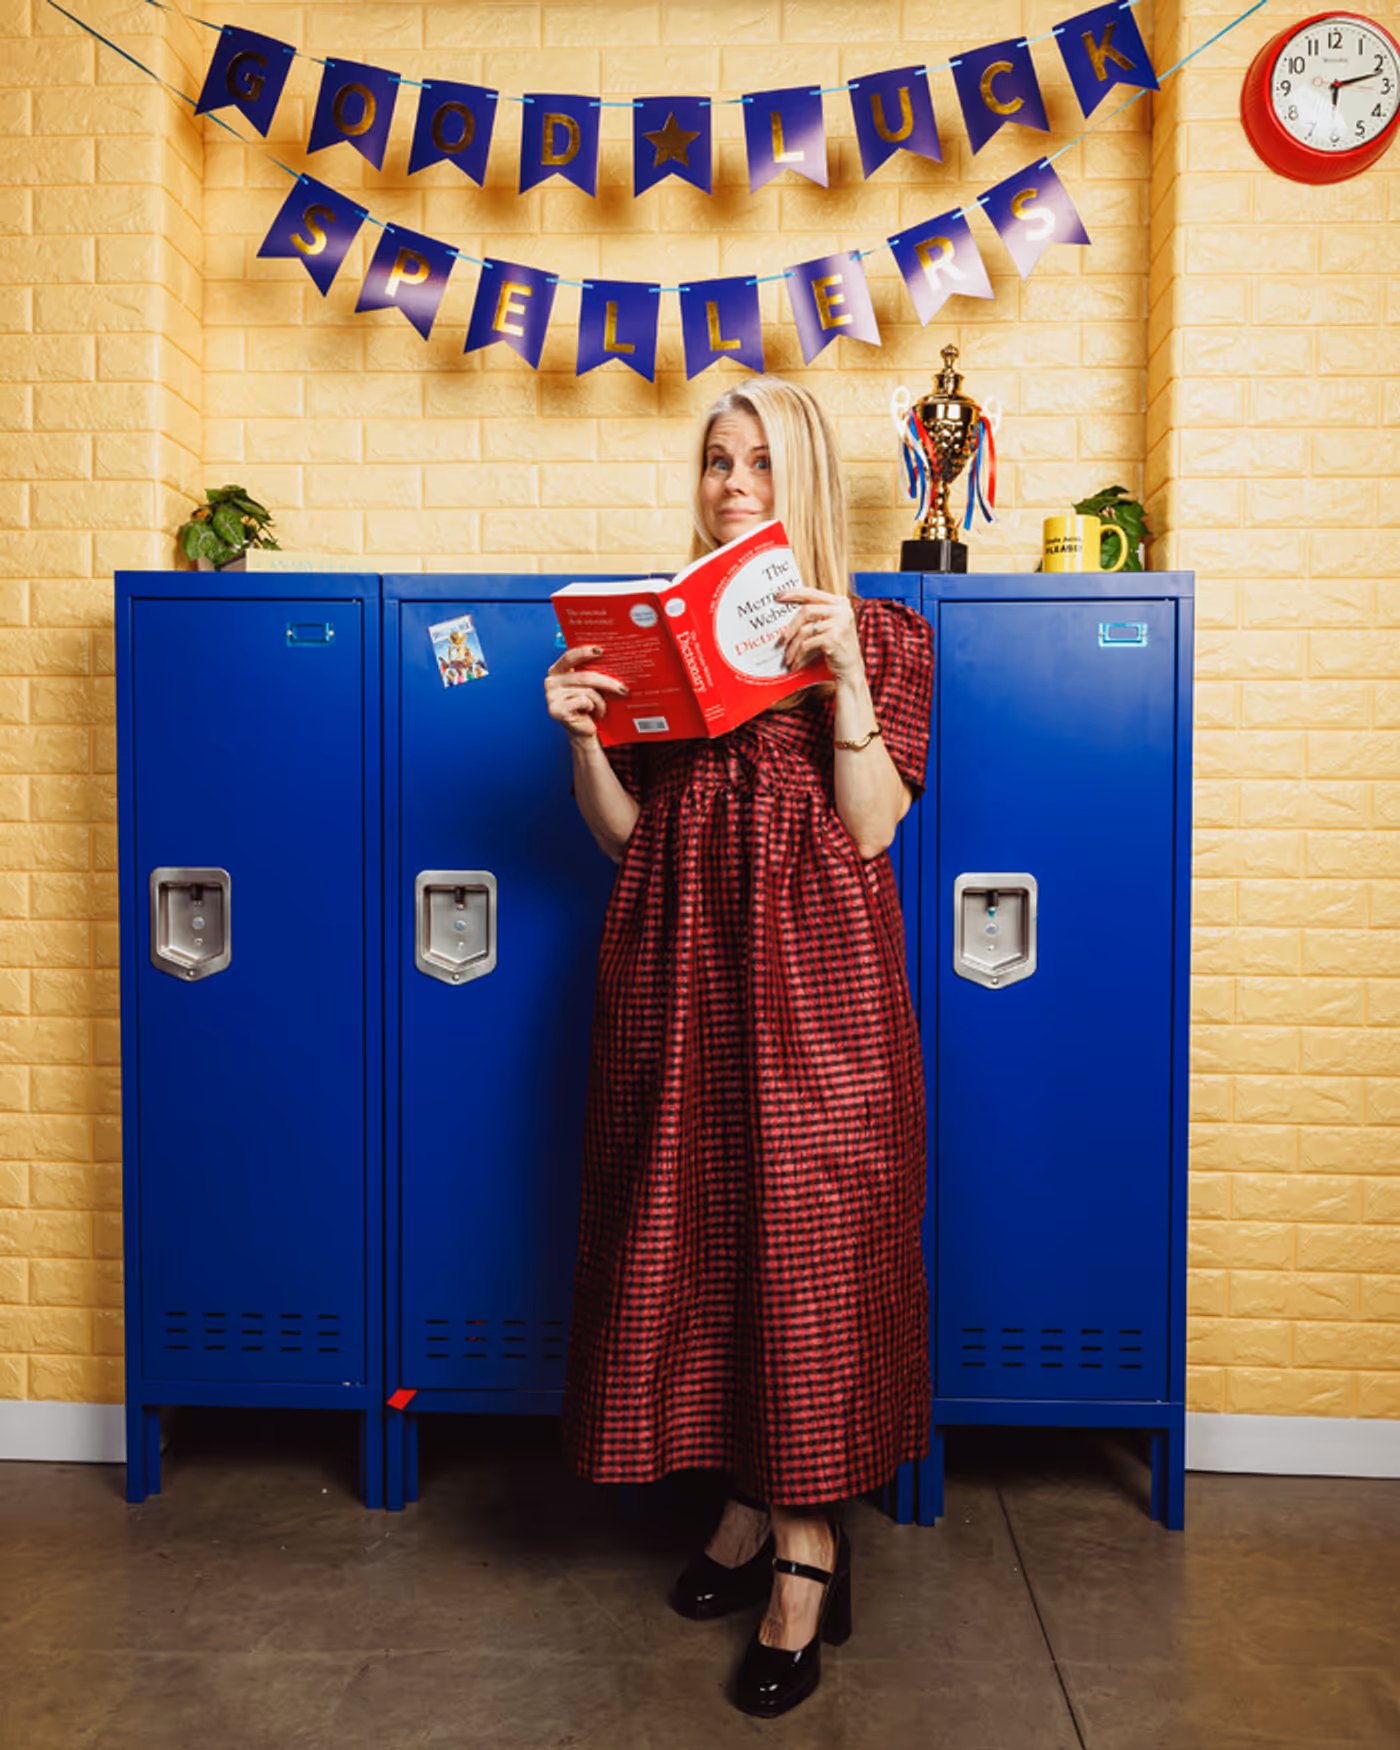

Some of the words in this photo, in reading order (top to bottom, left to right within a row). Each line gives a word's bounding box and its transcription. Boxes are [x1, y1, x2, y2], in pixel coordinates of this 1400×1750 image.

[1307, 39, 1319, 56] 11
[1328, 32, 1343, 49] 12
[1358, 39, 1364, 56] 1
[1288, 56, 1305, 74] 10
[1374, 54, 1384, 72] 2
[225, 50, 581, 166] GOOD
[770, 22, 1136, 163] LUCK
[1280, 80, 1291, 96] 9
[1380, 78, 1391, 95] 3
[1288, 104, 1298, 120] 8
[1371, 103, 1382, 117] 4
[1355, 120, 1365, 136] 5
[290, 188, 1056, 354] SPELLERS
[762, 561, 789, 581] The
[750, 602, 797, 629] Webste
[735, 625, 787, 656] Diction
[676, 630, 706, 693] Dictionary
